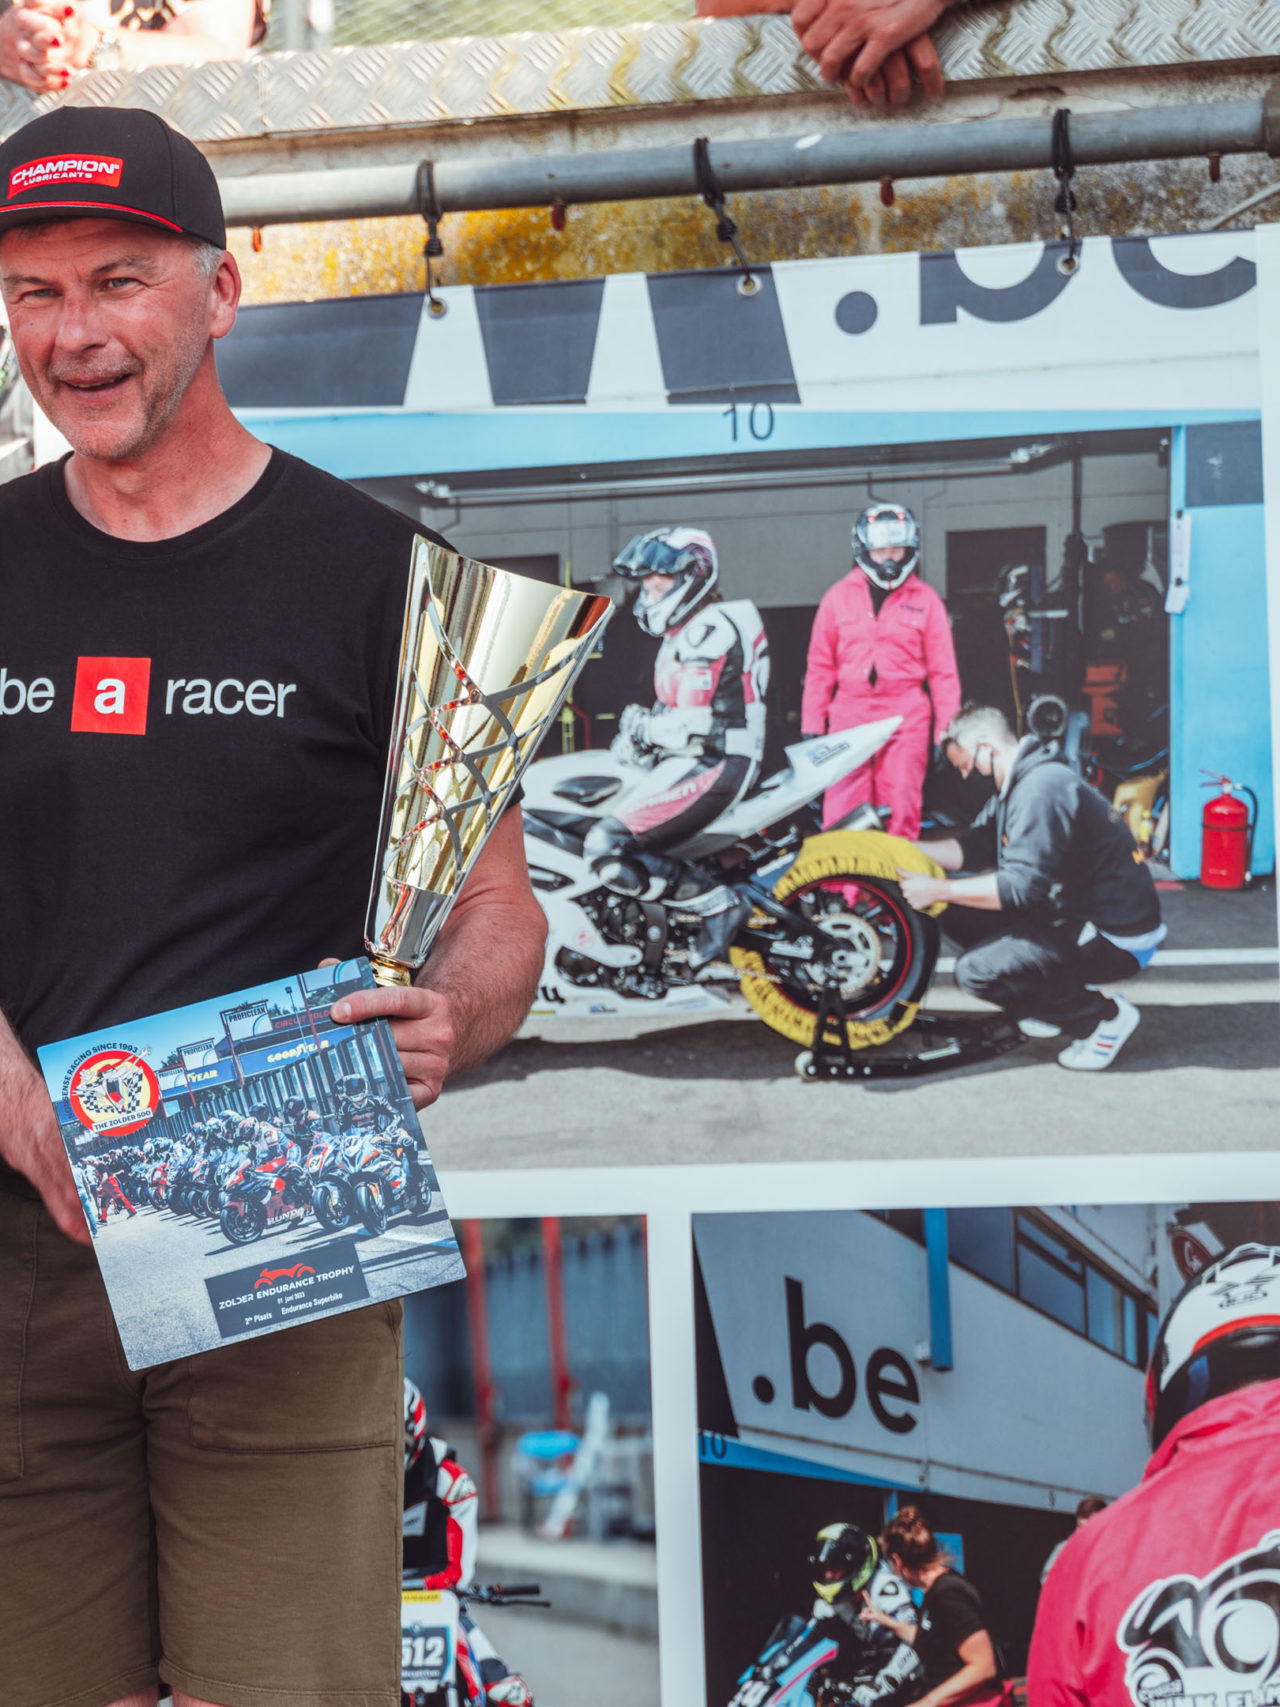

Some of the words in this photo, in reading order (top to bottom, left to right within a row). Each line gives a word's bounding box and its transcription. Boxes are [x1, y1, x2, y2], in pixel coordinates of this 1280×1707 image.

[23, 171, 93, 187] LUBRICANTS
[722, 401, 775, 442] 10
[93, 677, 127, 715] a
[165, 677, 297, 718] racer
[228, 1006, 267, 1023] PROFICLEAN
[66, 1049, 92, 1075] RACING
[92, 1042, 118, 1053] SINCE
[118, 1042, 138, 1054] 1993
[183, 1043, 214, 1056] PROFICLEAN
[94, 1123, 109, 1131] THE
[109, 1114, 136, 1126] ZOLDER
[136, 1110, 151, 1119] 500
[218, 1294, 255, 1310] ZOLDER
[256, 1276, 315, 1300] ENDURANCE
[316, 1265, 355, 1283] TROPHY
[285, 1294, 294, 1304] juni
[253, 1311, 273, 1323] Plaats
[281, 1301, 313, 1315] Endurance
[313, 1292, 343, 1307] Superbike
[752, 1274, 921, 1434] .be
